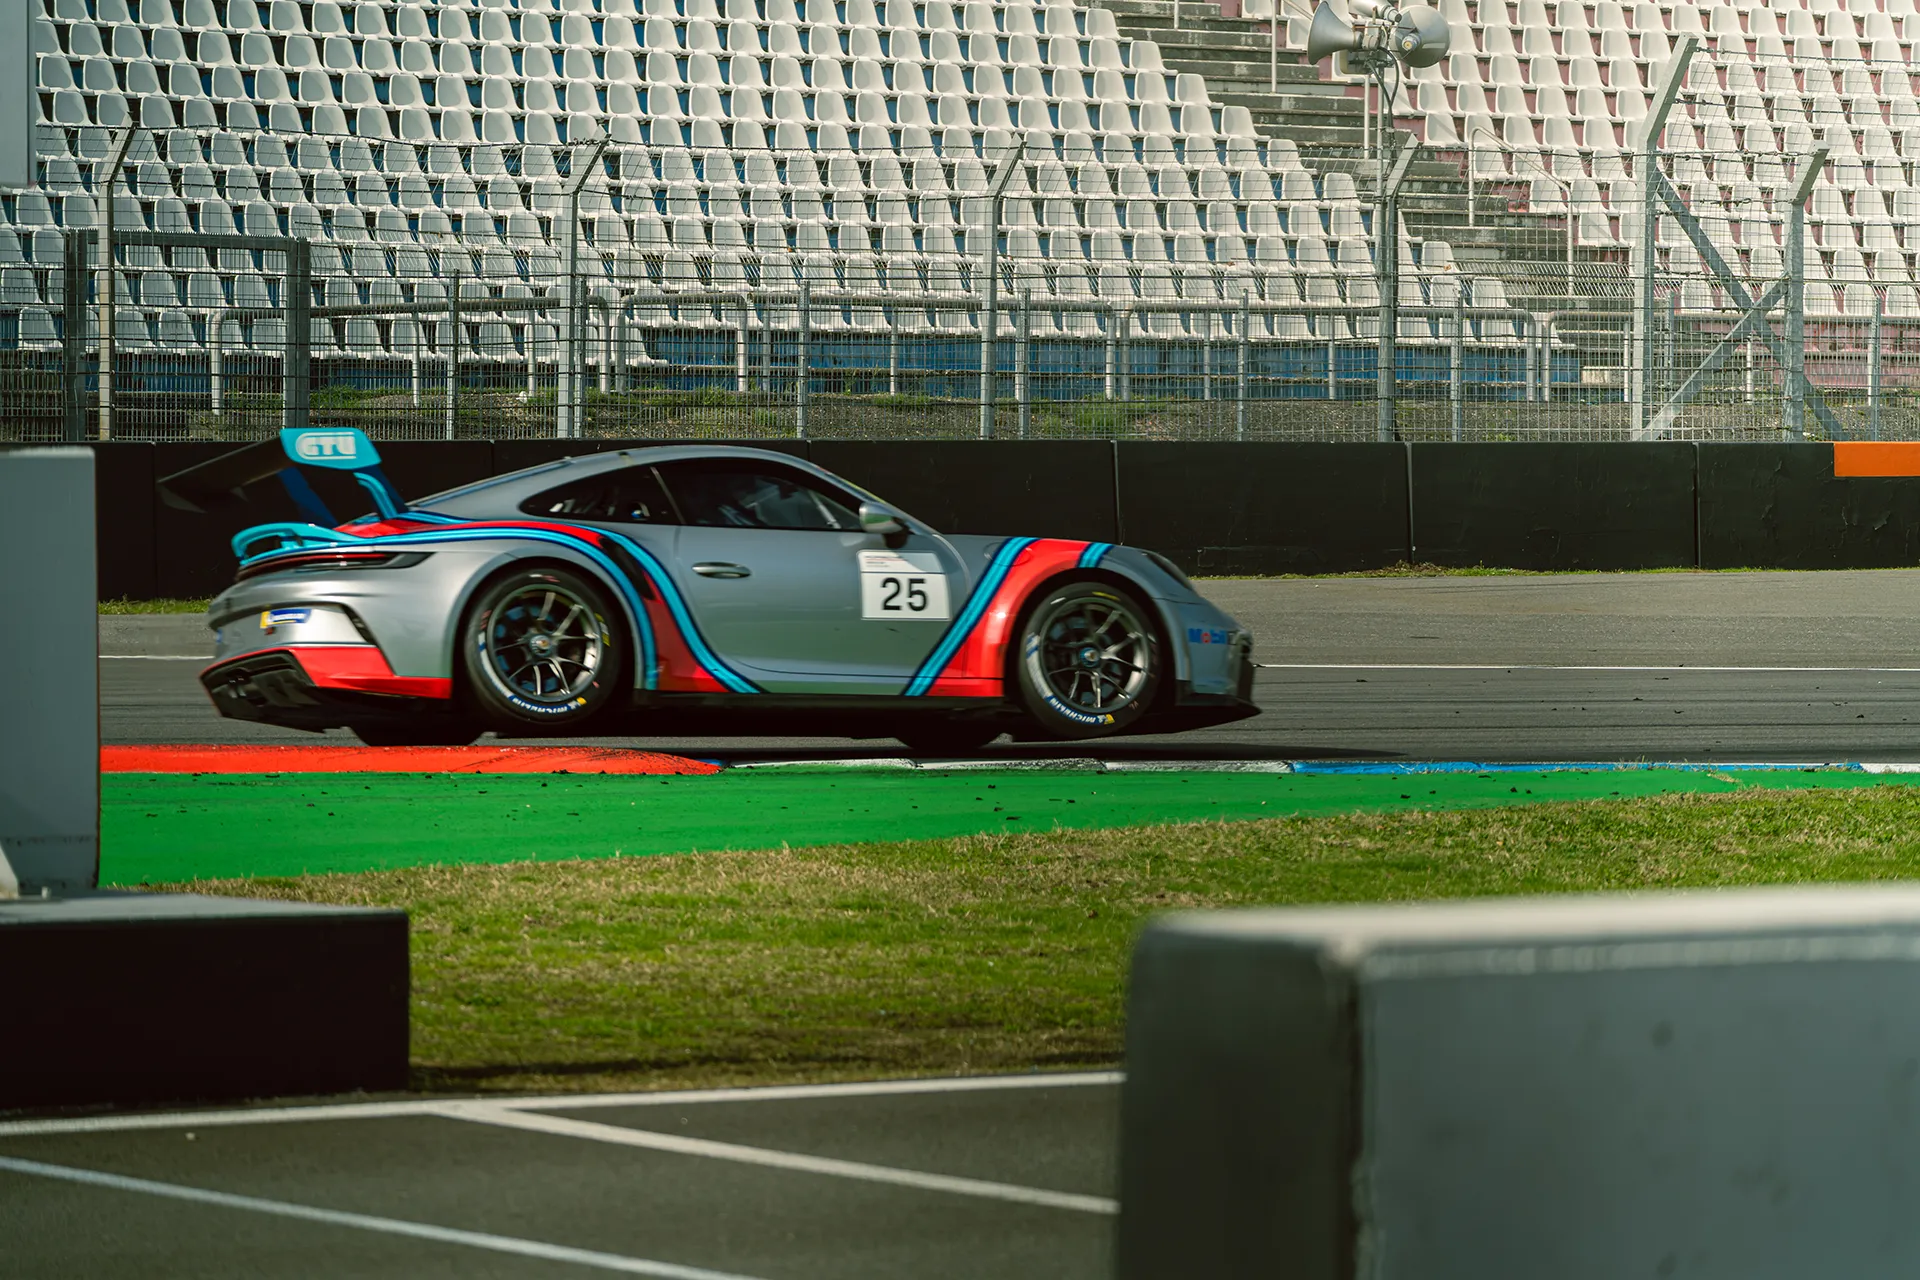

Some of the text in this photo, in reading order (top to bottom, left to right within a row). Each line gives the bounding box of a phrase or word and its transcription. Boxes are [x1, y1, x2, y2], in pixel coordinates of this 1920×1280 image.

[881, 577, 927, 611] 25
[1188, 628, 1227, 644] Mobil
[1049, 697, 1096, 723] MICHELIN
